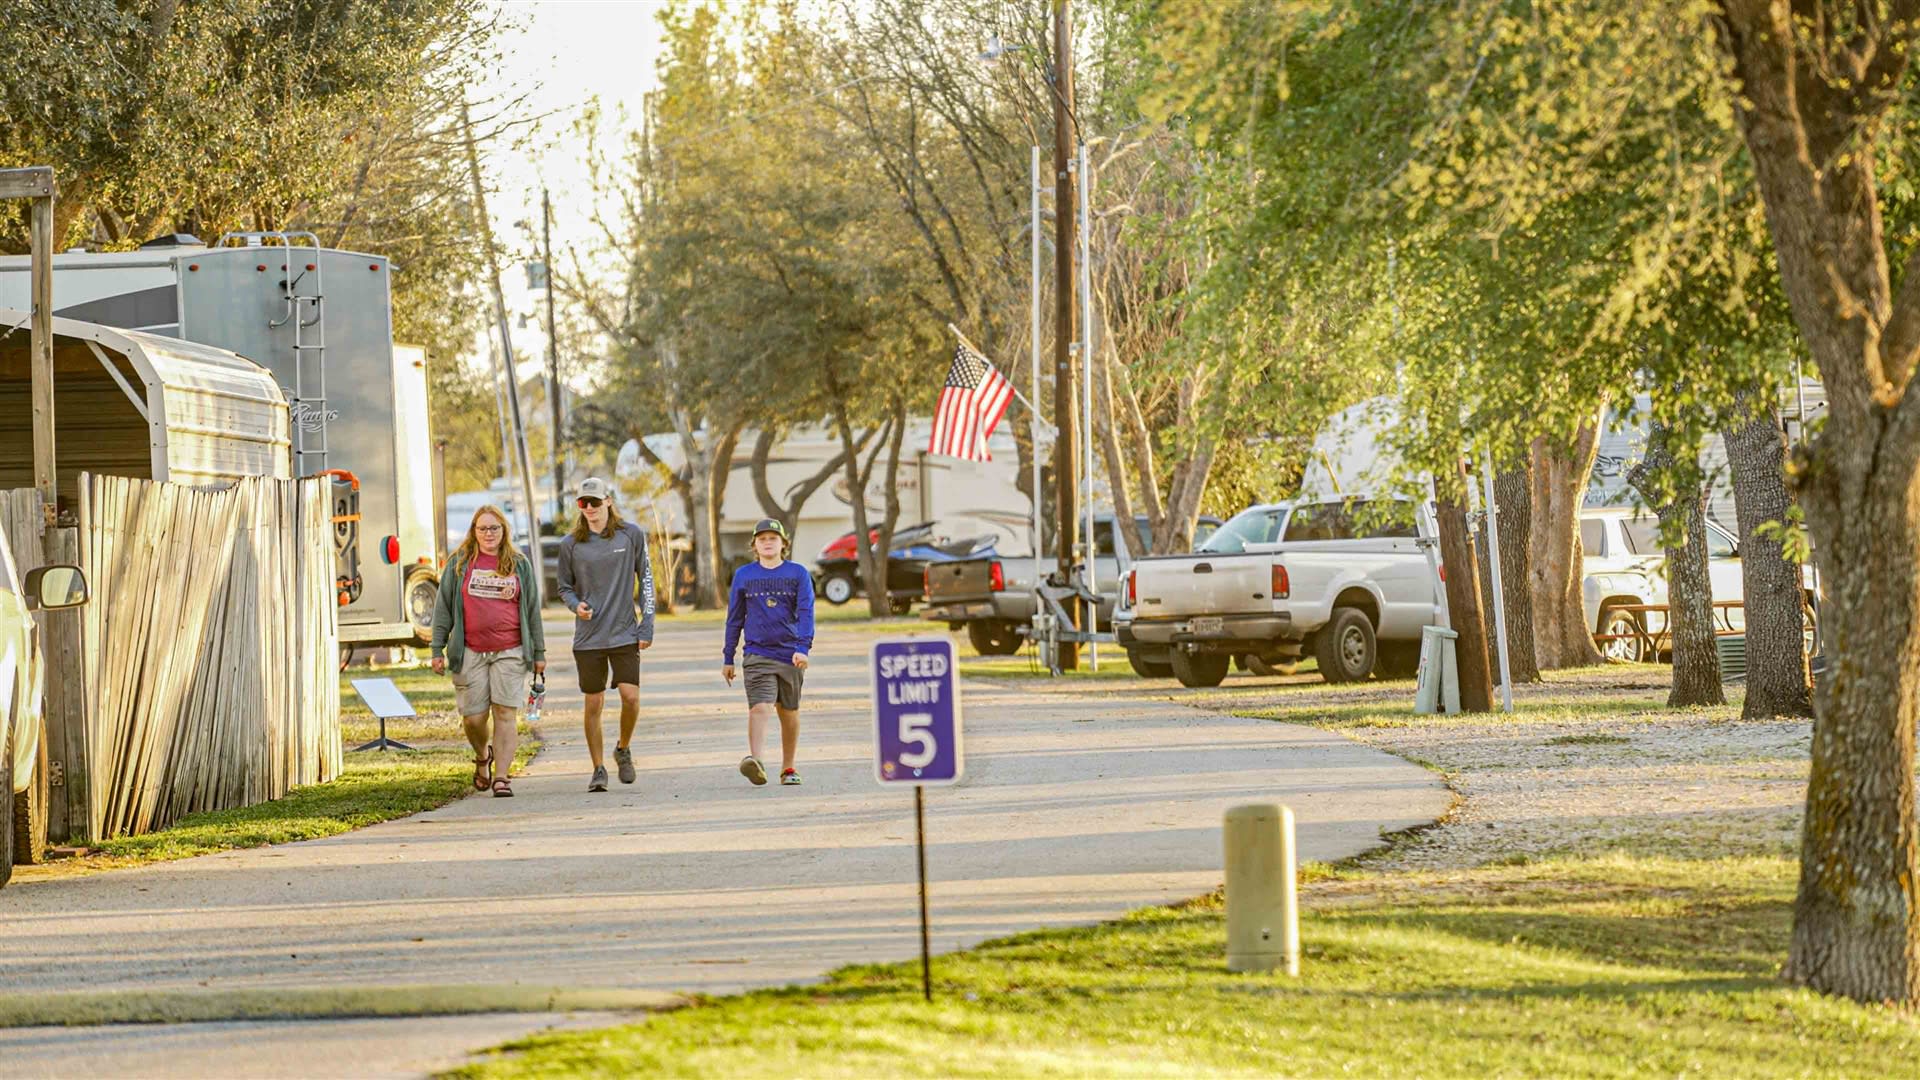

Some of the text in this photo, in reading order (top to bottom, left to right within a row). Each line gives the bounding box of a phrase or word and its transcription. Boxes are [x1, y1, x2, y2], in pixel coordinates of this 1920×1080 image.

[879, 653, 949, 679] SPEED
[887, 681, 942, 705] LIMIT
[898, 712, 938, 768] 5
